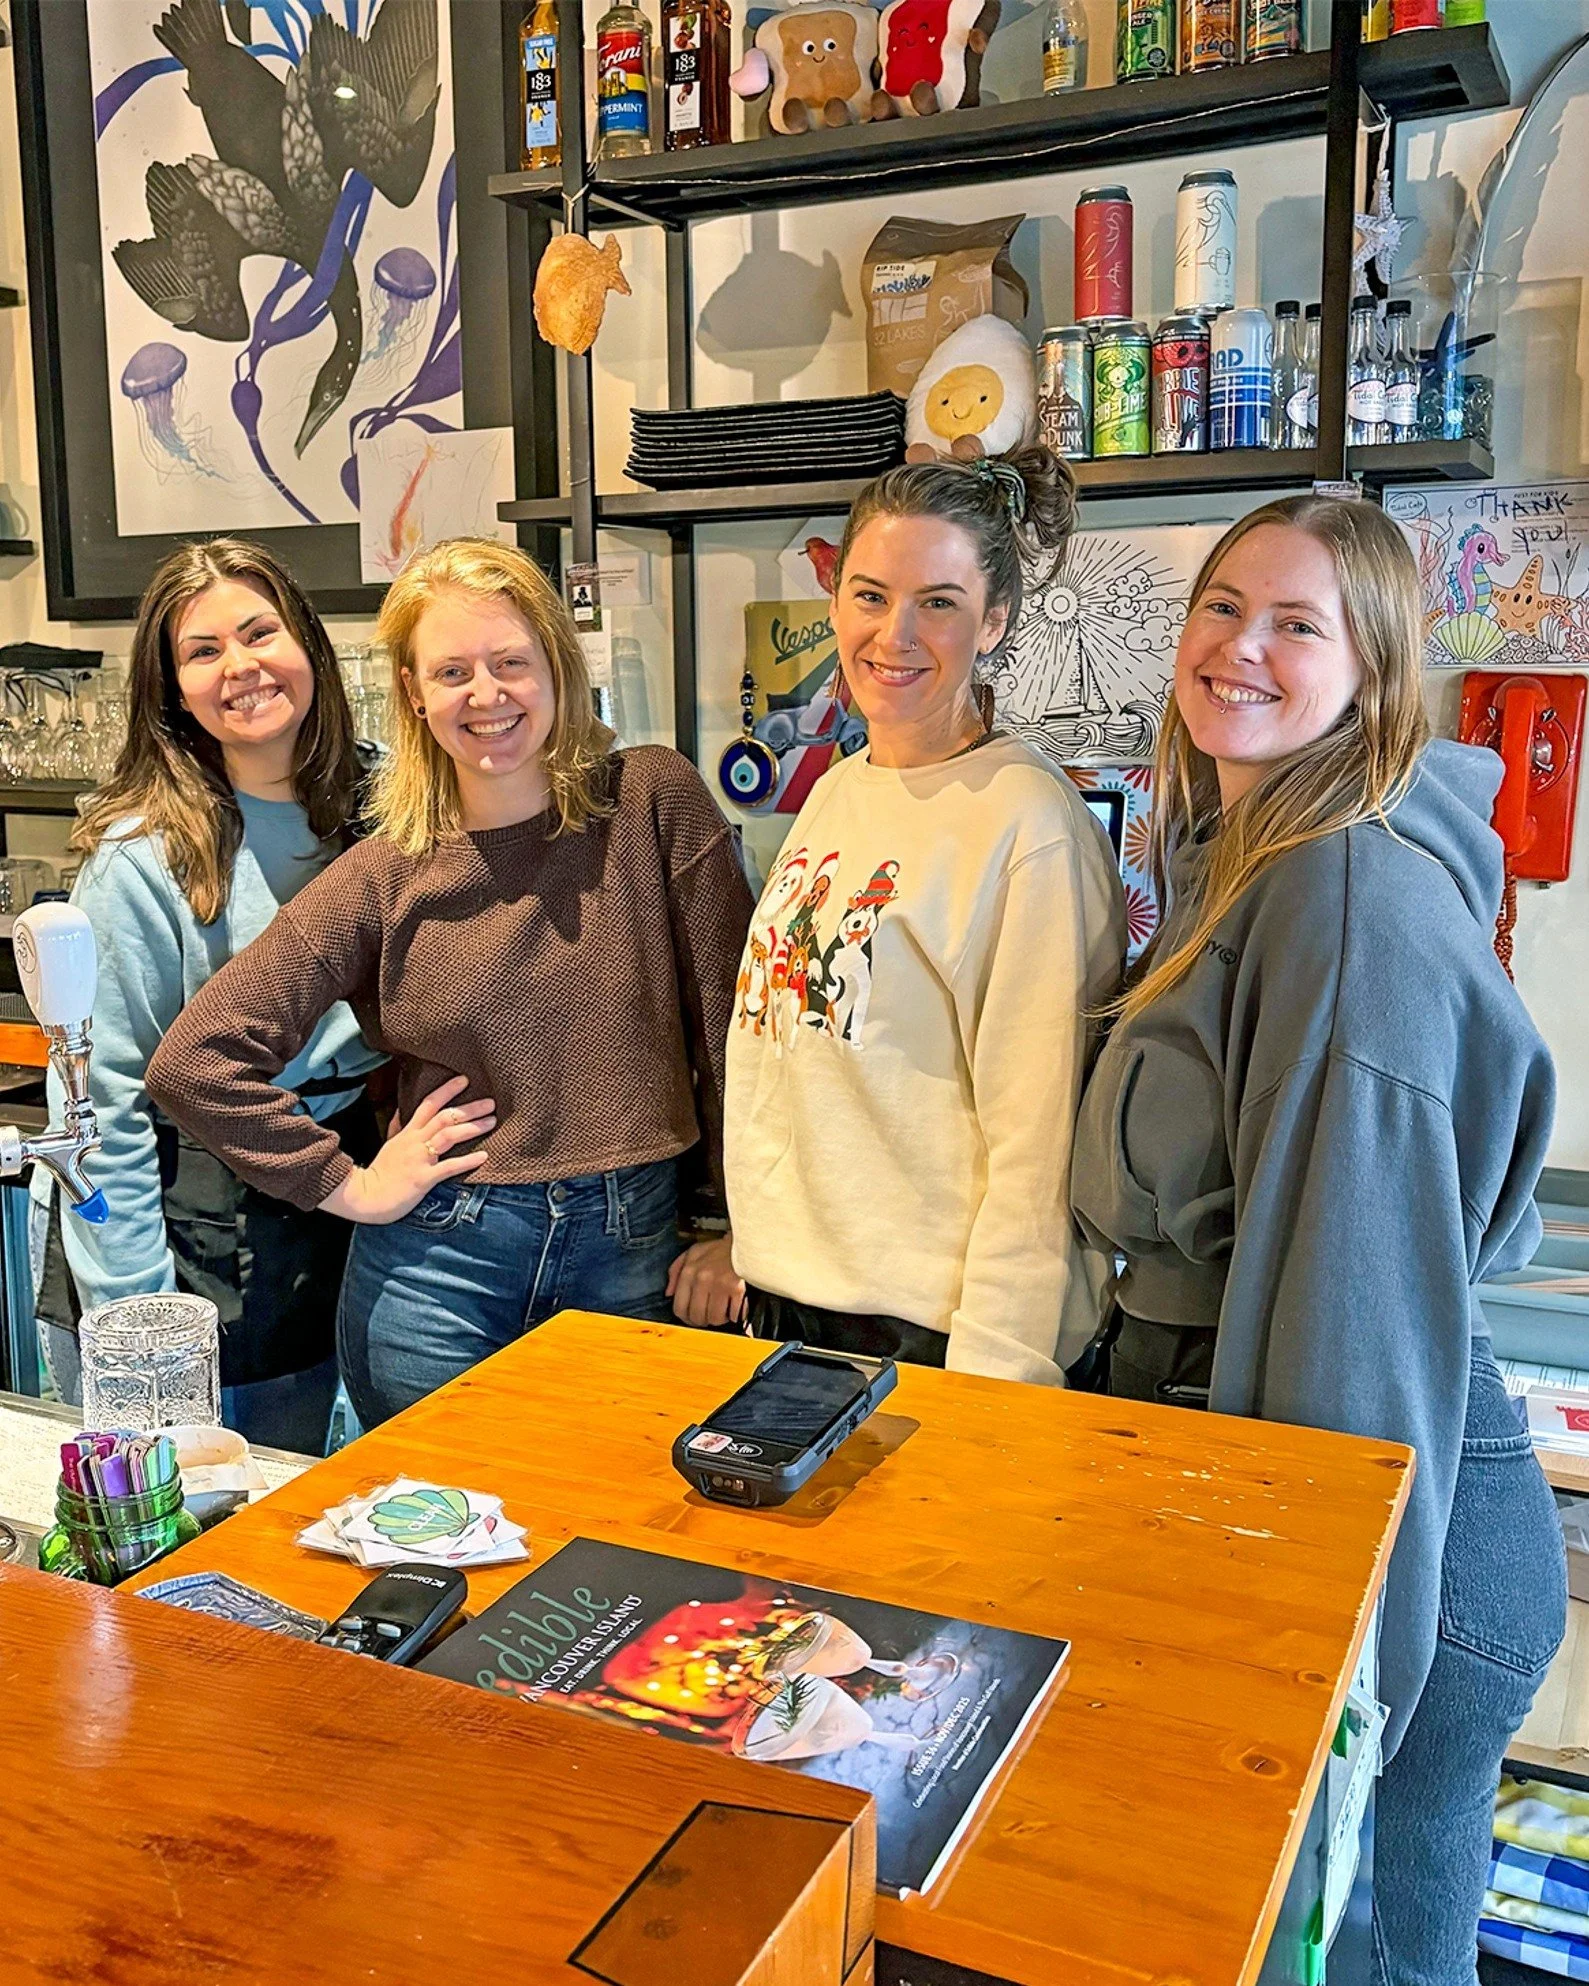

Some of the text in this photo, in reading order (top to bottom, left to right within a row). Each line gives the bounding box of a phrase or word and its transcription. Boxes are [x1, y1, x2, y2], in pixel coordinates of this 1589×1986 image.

[887, 325, 925, 344] LAKES
[1039, 410, 1079, 428] STEAM
[1046, 428, 1083, 448] PUNK
[1465, 489, 1574, 524] THANK
[591, 1594, 643, 1637] ISLAND
[475, 1587, 611, 1696] edible
